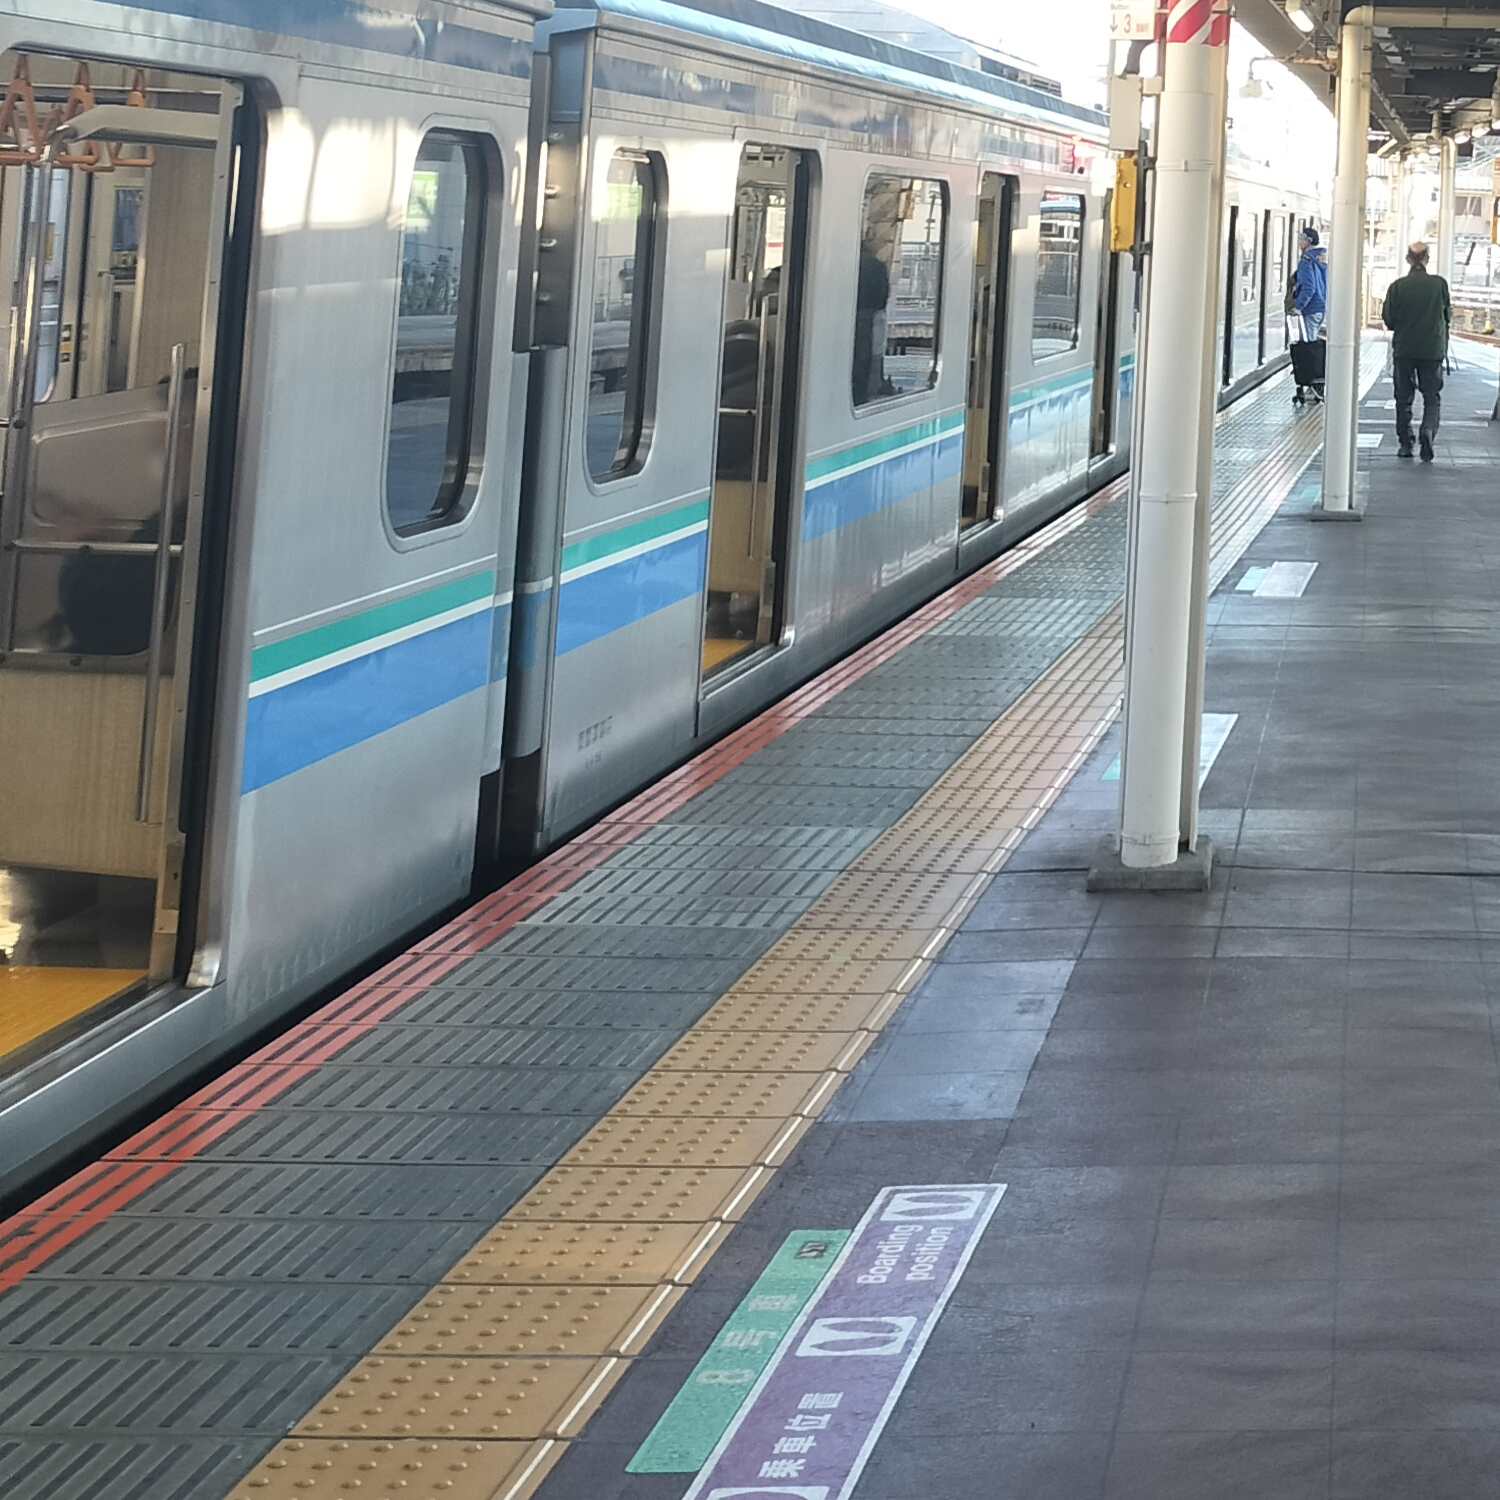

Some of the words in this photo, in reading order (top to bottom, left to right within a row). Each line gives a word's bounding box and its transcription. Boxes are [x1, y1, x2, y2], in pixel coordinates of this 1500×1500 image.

[1123, 13, 1131, 34] 3
[857, 1224, 924, 1285] Boarding
[905, 1226, 954, 1282] position
[696, 1293, 798, 1386] 8号車
[758, 1391, 844, 1478] 乗車位置
